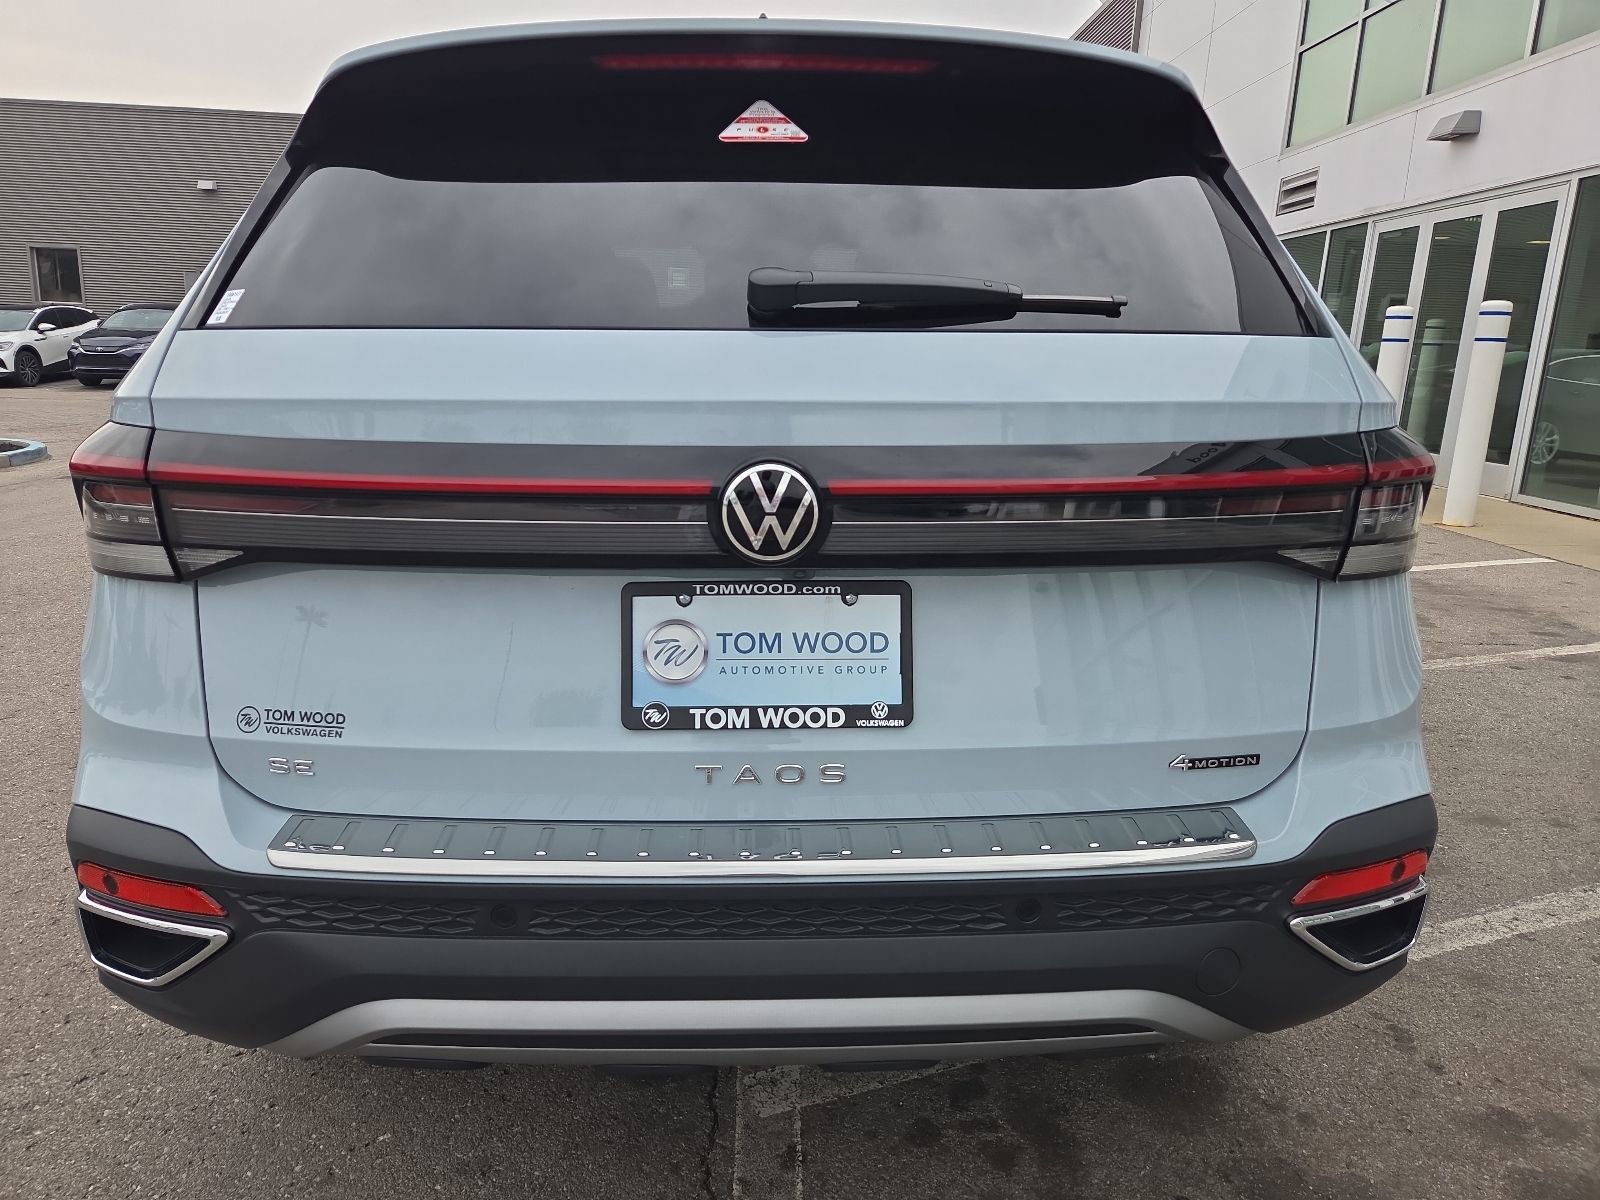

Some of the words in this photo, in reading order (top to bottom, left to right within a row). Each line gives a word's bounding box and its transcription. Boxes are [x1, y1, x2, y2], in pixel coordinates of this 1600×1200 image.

[692, 583, 841, 595] TOMWOOD.com
[716, 631, 783, 654] TOM
[792, 631, 890, 654] WOOD
[719, 665, 825, 675] AUTOMOTIVE
[834, 665, 889, 675] GROUP
[264, 708, 295, 722] TOM
[299, 710, 346, 725] WOOD
[689, 707, 750, 730] TOM
[757, 706, 846, 729] WOOD
[855, 719, 905, 727] VOLKSWAGEN
[265, 725, 343, 739] VOLKSWAGEN
[268, 756, 316, 776] SE
[694, 763, 847, 785] TAOS
